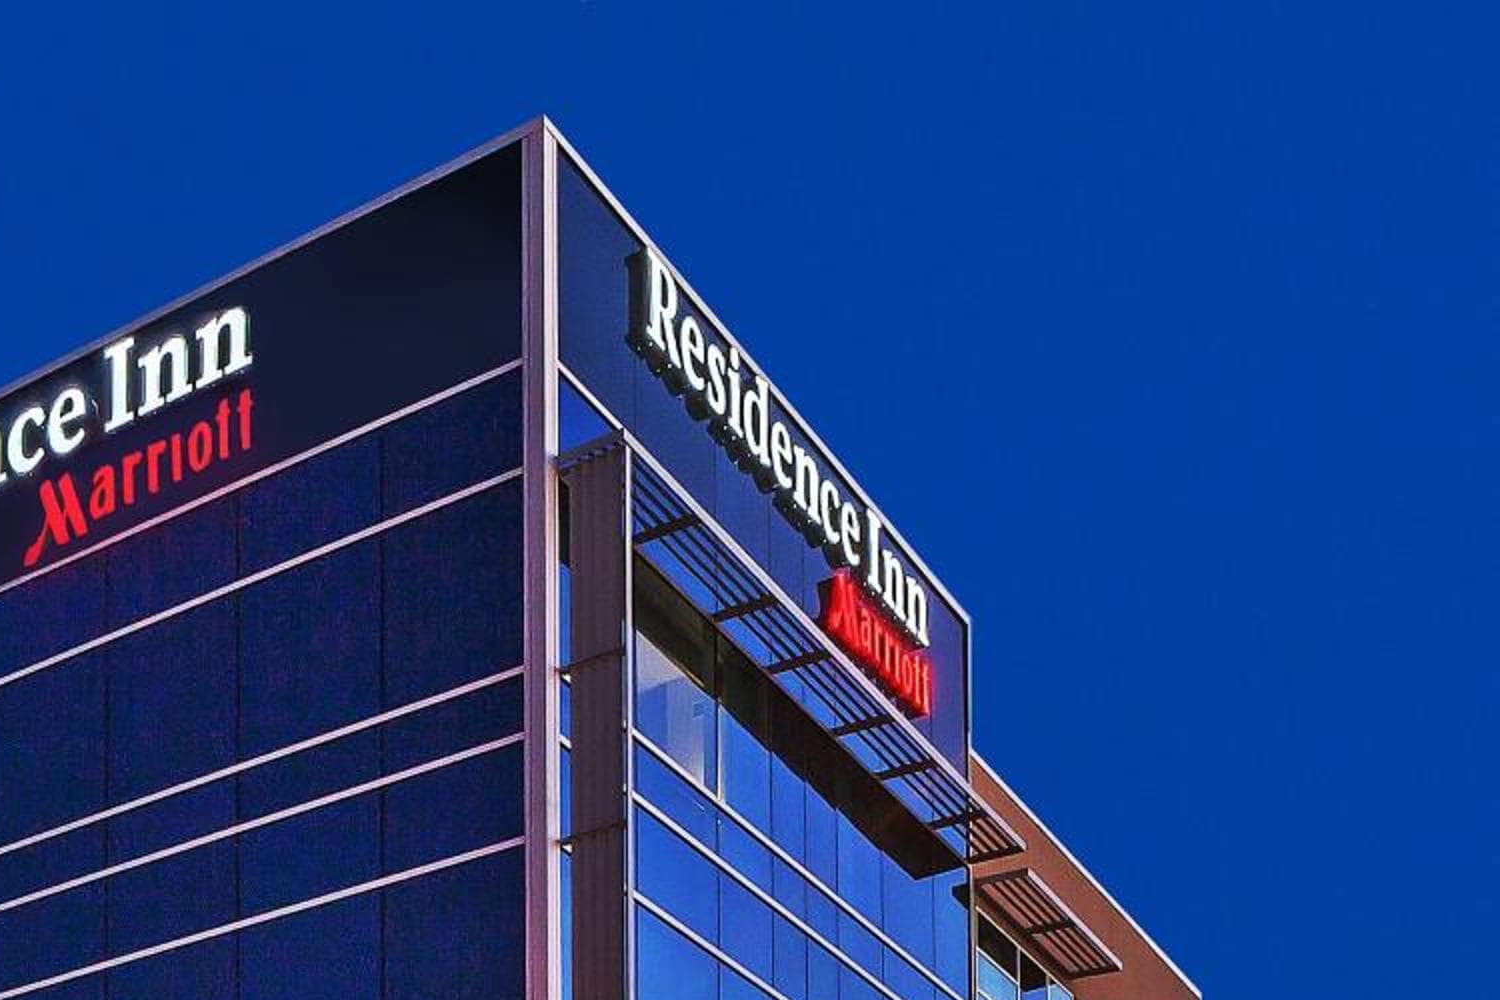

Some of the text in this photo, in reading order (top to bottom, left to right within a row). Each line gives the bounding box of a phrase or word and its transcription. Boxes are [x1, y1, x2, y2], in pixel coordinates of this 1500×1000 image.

[103, 304, 253, 433] Inn
[646, 246, 930, 647] Residence Inn
[23, 388, 255, 568] Marriott
[824, 571, 932, 714] Marriott
